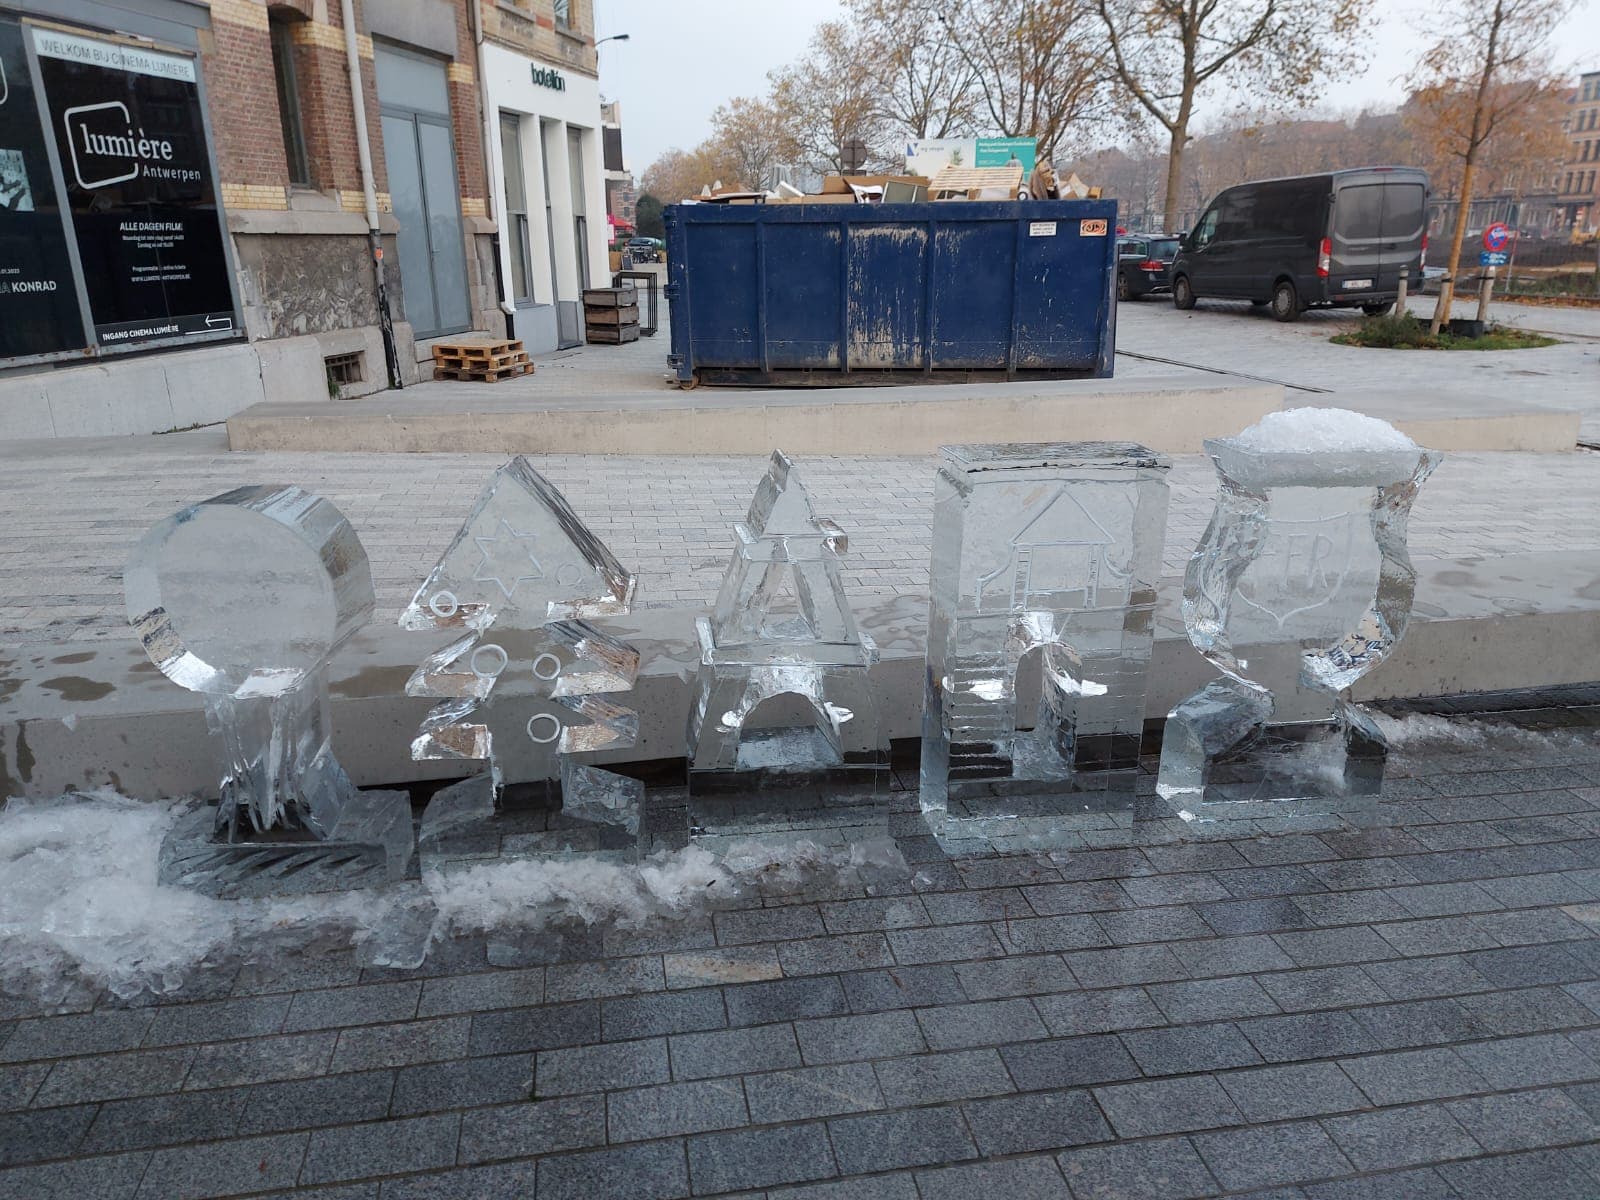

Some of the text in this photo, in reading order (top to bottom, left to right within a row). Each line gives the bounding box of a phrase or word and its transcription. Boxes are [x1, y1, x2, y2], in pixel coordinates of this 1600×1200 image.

[42, 39, 90, 57] WELKOM
[93, 48, 109, 61] BIJ
[111, 53, 150, 68] CINEMA
[531, 62, 566, 92] botellón
[80, 123, 173, 160] lumière
[143, 165, 201, 182] Antwerpen
[120, 222, 138, 231] ALLE
[139, 222, 164, 231] DAGEN
[11, 280, 57, 293] KONRAD
[103, 324, 179, 341] INGANG CINEMA LUMIÈRE
